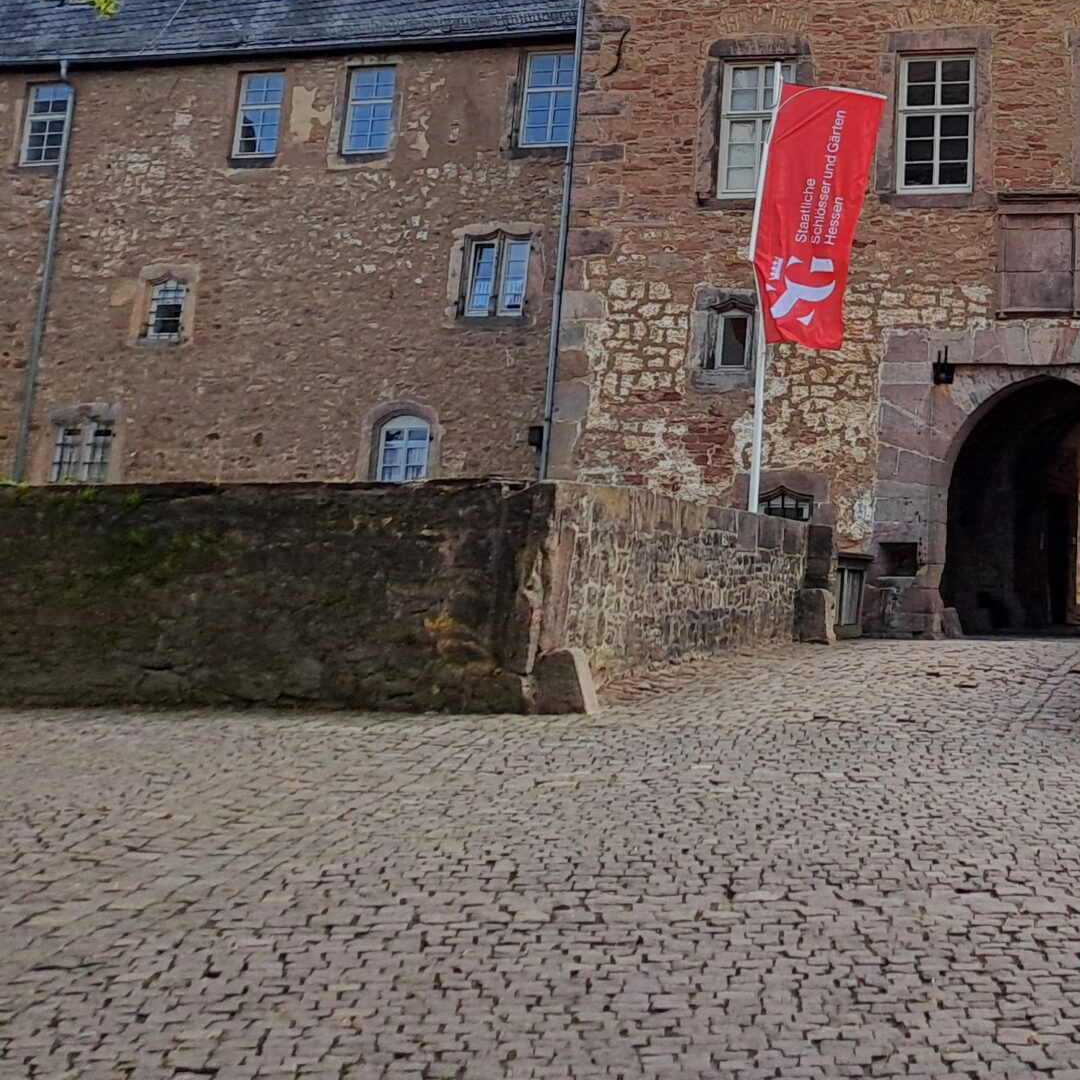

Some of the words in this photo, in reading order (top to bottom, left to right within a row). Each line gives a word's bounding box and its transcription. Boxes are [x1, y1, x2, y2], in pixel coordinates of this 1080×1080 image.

[827, 110, 847, 153] Gärten
[825, 156, 837, 179] und
[795, 177, 816, 243] Staatliche
[811, 179, 831, 245] Schlösser
[824, 196, 844, 246] Hessen
